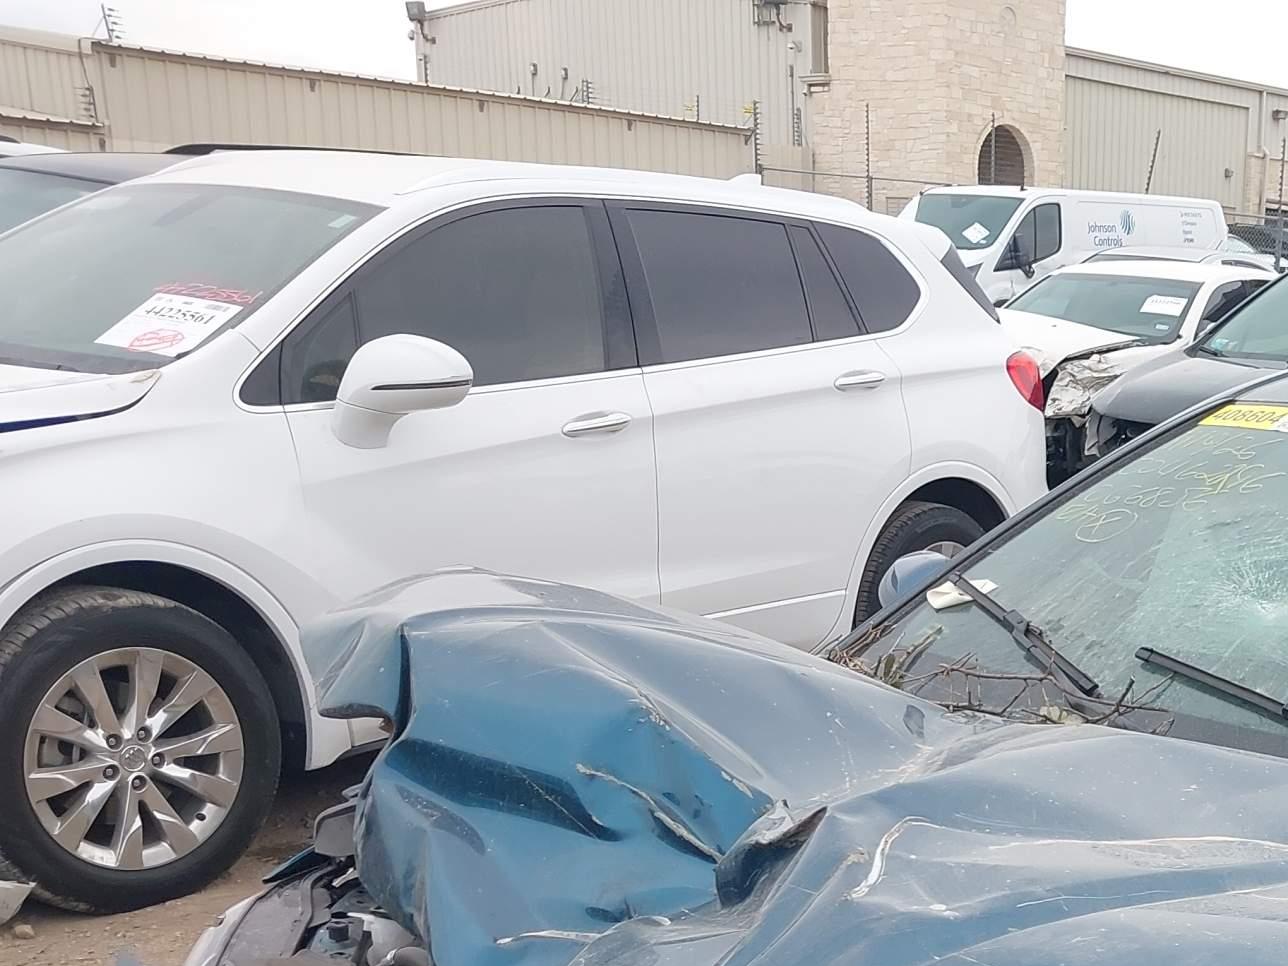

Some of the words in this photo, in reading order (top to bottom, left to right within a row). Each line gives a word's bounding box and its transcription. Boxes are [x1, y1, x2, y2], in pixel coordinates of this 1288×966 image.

[1087, 221, 1117, 234] Johnson
[1093, 235, 1123, 247] Controls
[1213, 409, 1288, 424] 408604
